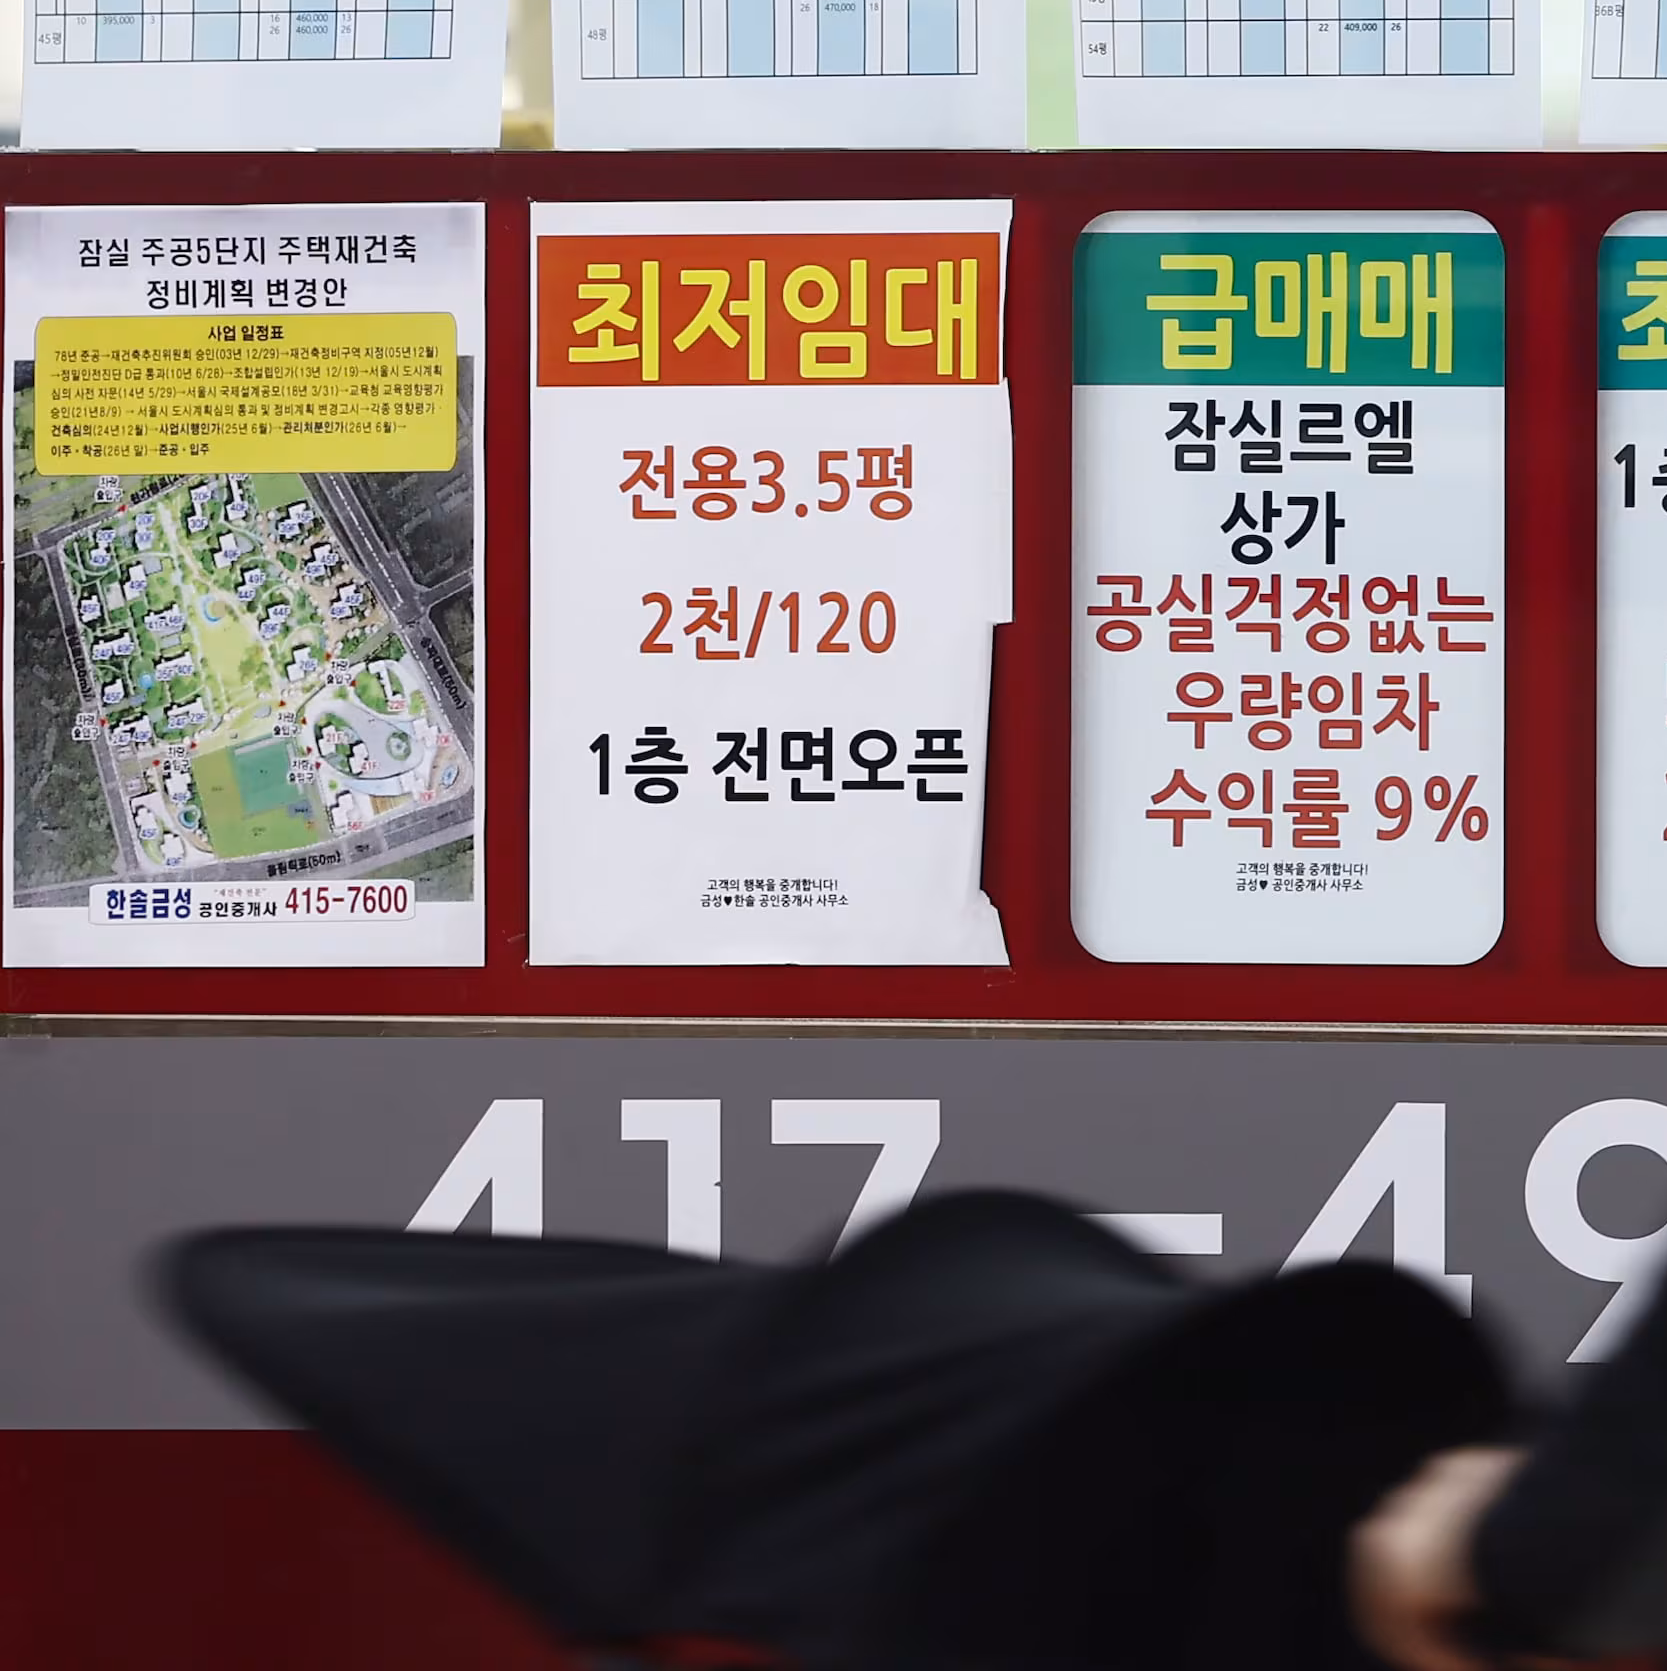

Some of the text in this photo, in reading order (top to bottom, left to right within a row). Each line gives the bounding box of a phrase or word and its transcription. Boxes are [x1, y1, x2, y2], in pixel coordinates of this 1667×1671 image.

[80, 235, 416, 267] 잠실 주공5단지 주택재건축
[147, 278, 347, 309] 정비계획 변경안
[569, 259, 977, 381] 최저임대
[1147, 252, 1452, 373] 급매매
[208, 324, 284, 342] 사업 일정표
[1165, 400, 1413, 474] 잠실르엘
[619, 444, 912, 520] 전용3.5평
[1221, 491, 1345, 564] 상가
[640, 586, 896, 660] 2천/120
[1087, 574, 1493, 653] 공실걱정없는
[1167, 672, 1439, 751] 우량임차
[590, 727, 968, 803] 1층 전면오픈
[1146, 769, 1488, 848] 수익률 9%
[107, 889, 191, 919] 한솔금성
[199, 901, 277, 919] 공인중개사
[285, 885, 407, 914] 415-7600
[707, 879, 838, 891] 고객의 행복을 중개합니다!
[759, 894, 812, 907] 공인중개사
[816, 894, 849, 907] 사무소
